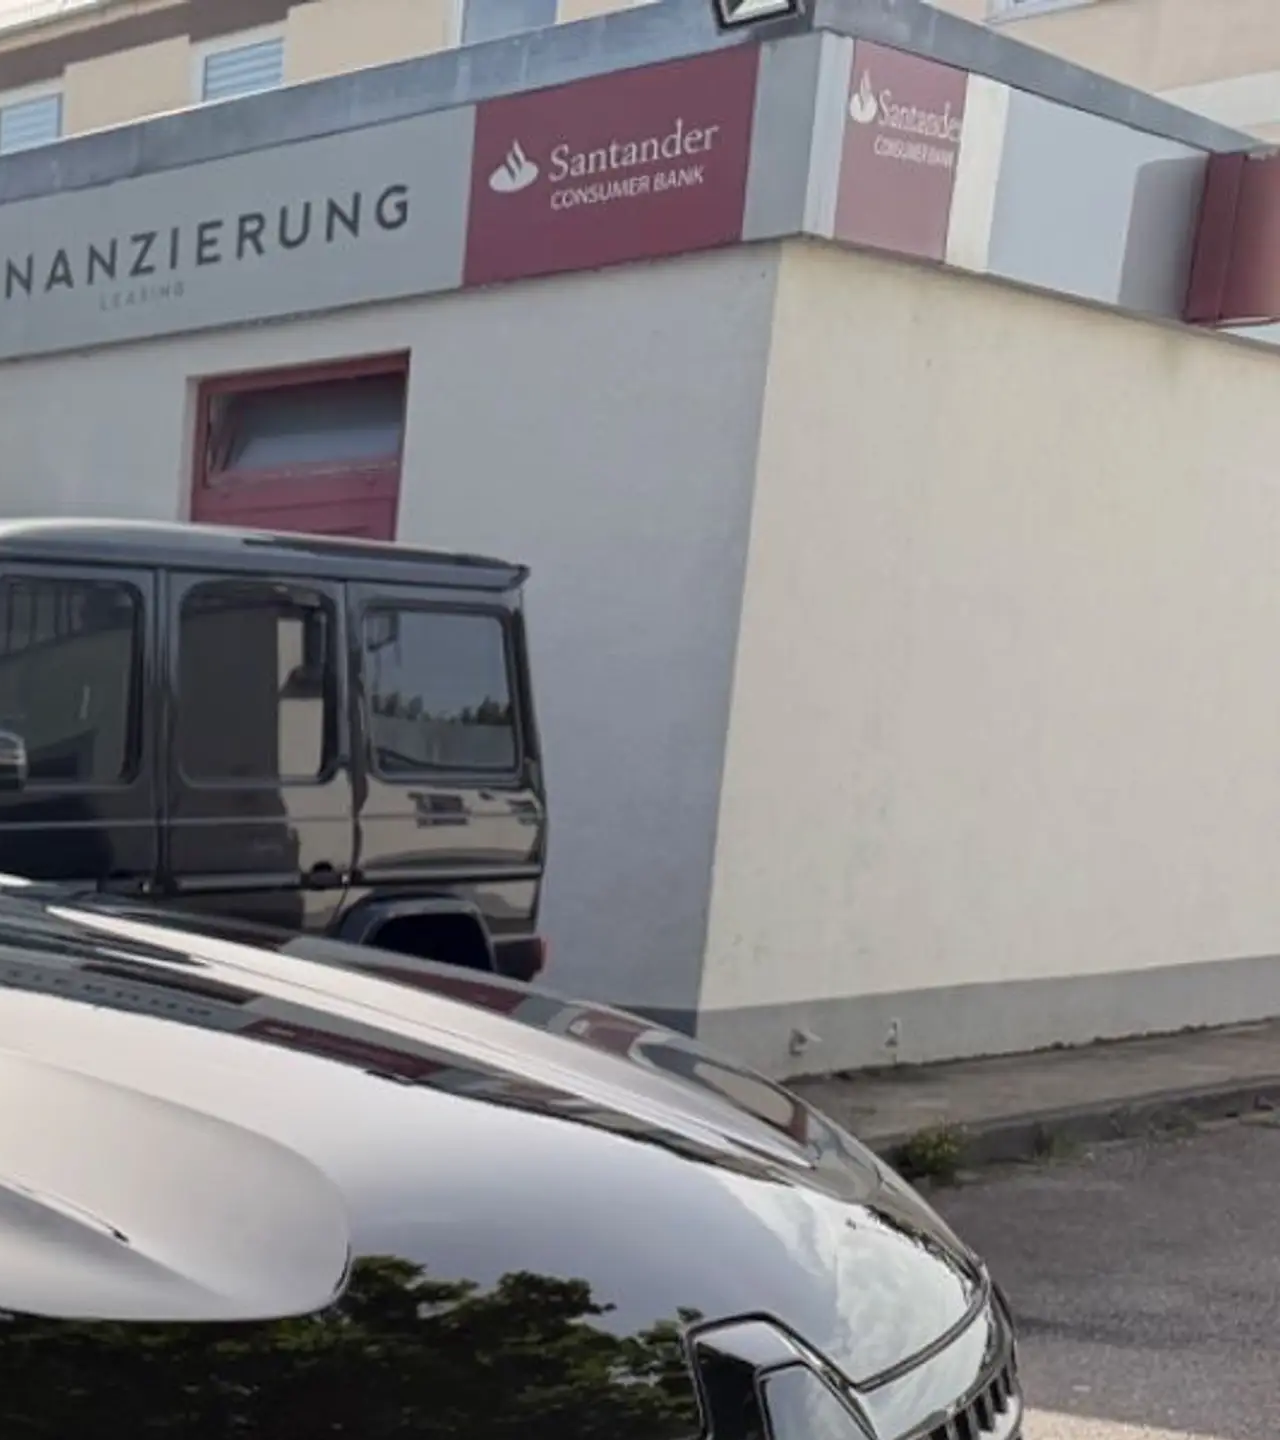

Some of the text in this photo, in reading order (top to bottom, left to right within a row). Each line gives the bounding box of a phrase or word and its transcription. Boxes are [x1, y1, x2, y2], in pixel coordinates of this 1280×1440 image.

[548, 115, 720, 182] Santander
[550, 165, 705, 210] CONSUMER BANK
